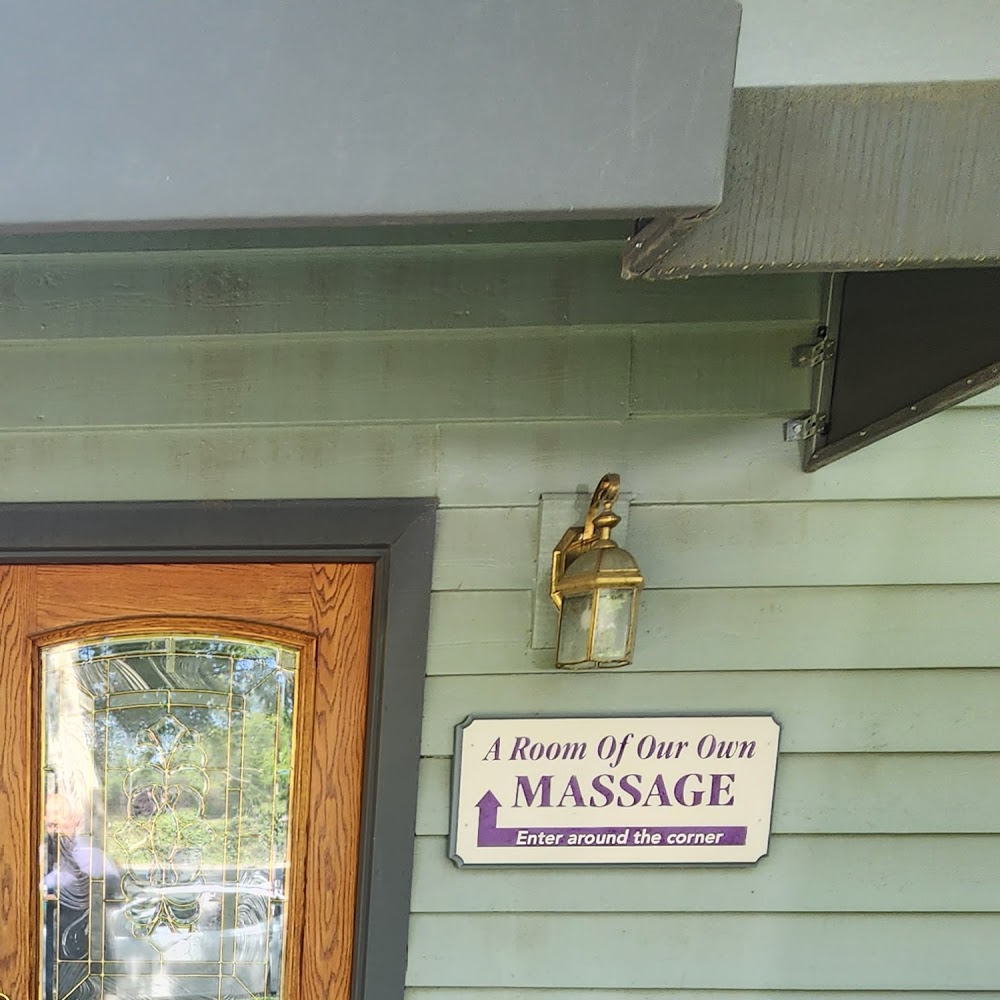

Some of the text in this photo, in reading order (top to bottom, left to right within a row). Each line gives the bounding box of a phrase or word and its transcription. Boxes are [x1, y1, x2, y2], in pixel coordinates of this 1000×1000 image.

[482, 733, 757, 768] A Room Of Our Own
[511, 773, 736, 808] MASSAGE
[516, 828, 724, 845] Enter around the corner
